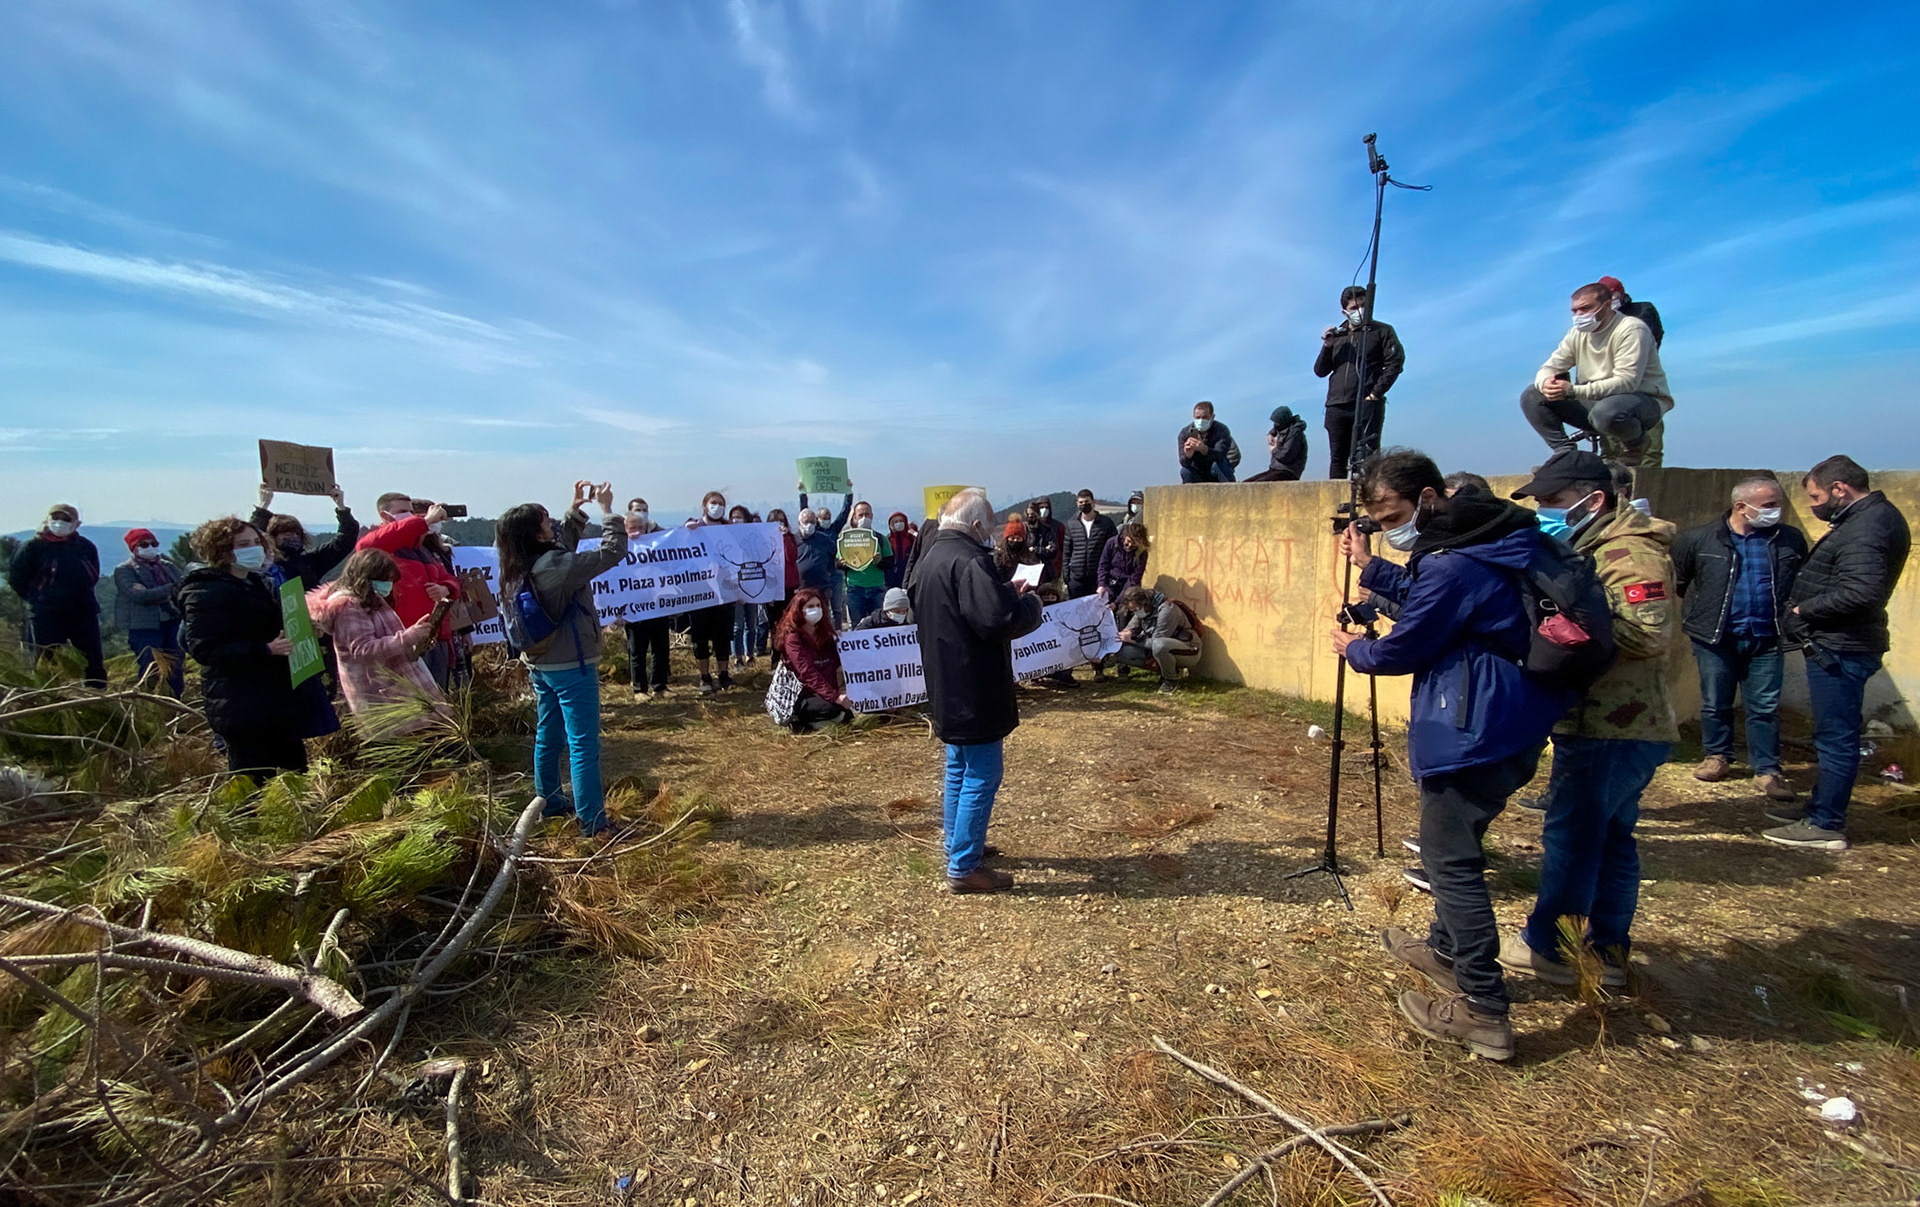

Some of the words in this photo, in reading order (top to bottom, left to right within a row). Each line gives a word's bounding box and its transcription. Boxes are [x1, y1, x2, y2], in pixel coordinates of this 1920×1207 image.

[625, 542, 708, 566] Dokunma!
[619, 577, 655, 592] Plaza
[659, 569, 716, 588] yapılmaz.
[596, 603, 628, 619] eykoz
[630, 600, 655, 615] Çevre
[659, 591, 715, 609] Dayanışması
[873, 631, 920, 650] Şehircil
[1013, 638, 1062, 660] yapılmaz.
[881, 694, 902, 708] Kent
[905, 692, 928, 704] Daya
